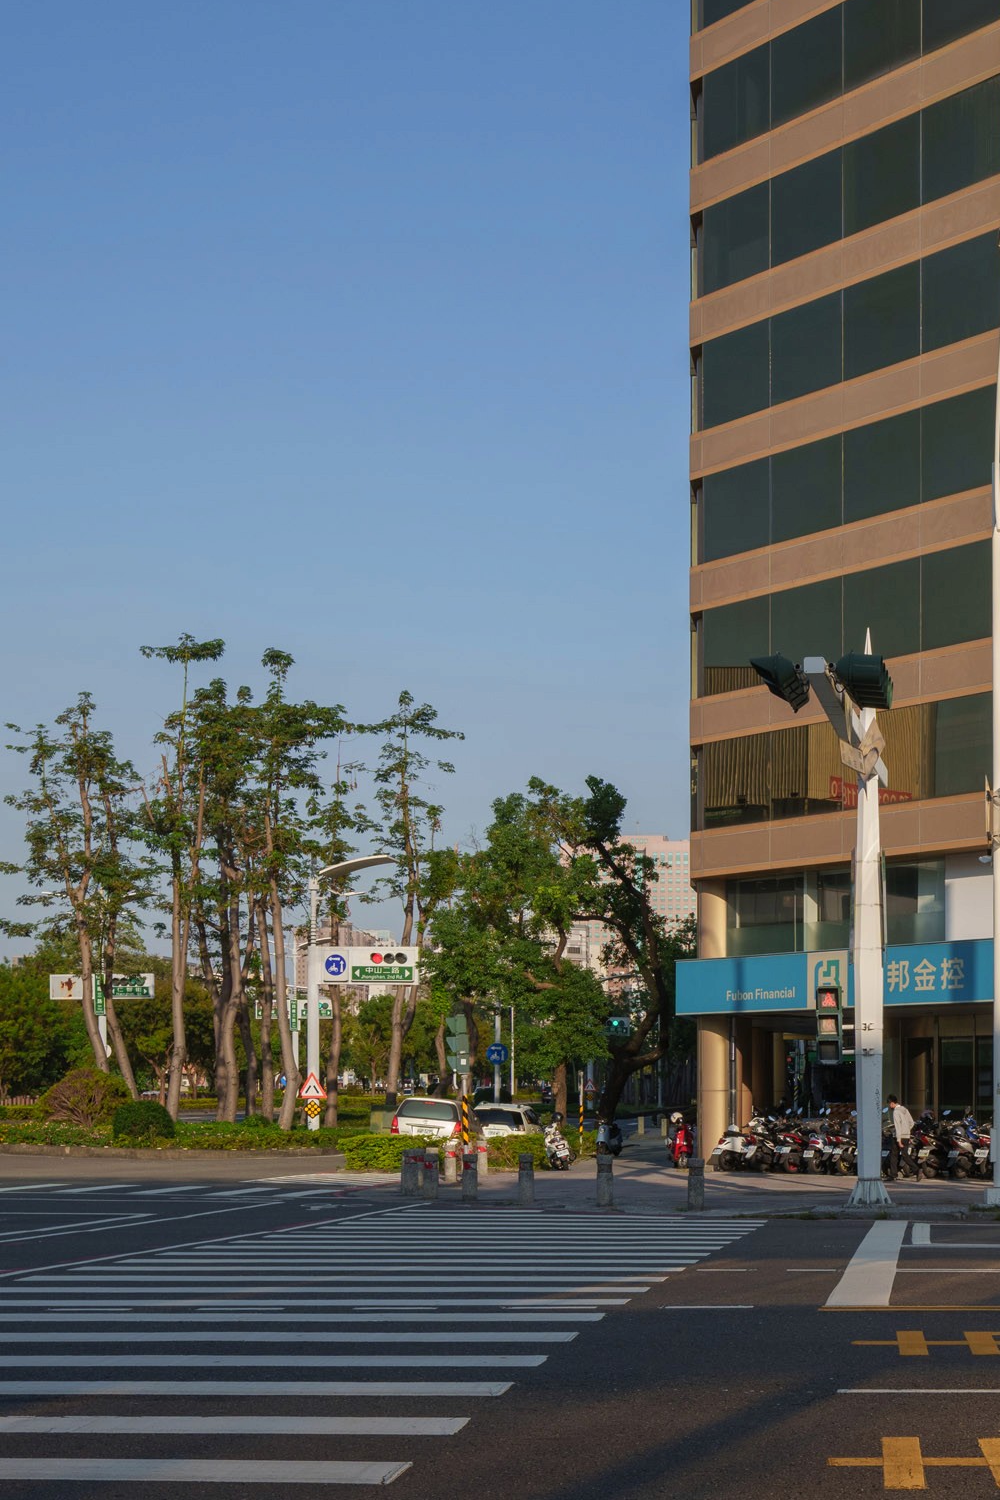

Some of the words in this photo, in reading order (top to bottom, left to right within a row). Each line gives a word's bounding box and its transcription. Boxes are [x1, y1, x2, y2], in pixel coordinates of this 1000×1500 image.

[365, 966, 400, 974] 中山二路
[887, 957, 965, 993] 邦金控
[726, 988, 754, 1002] Fubon
[755, 986, 796, 1000] Financial
